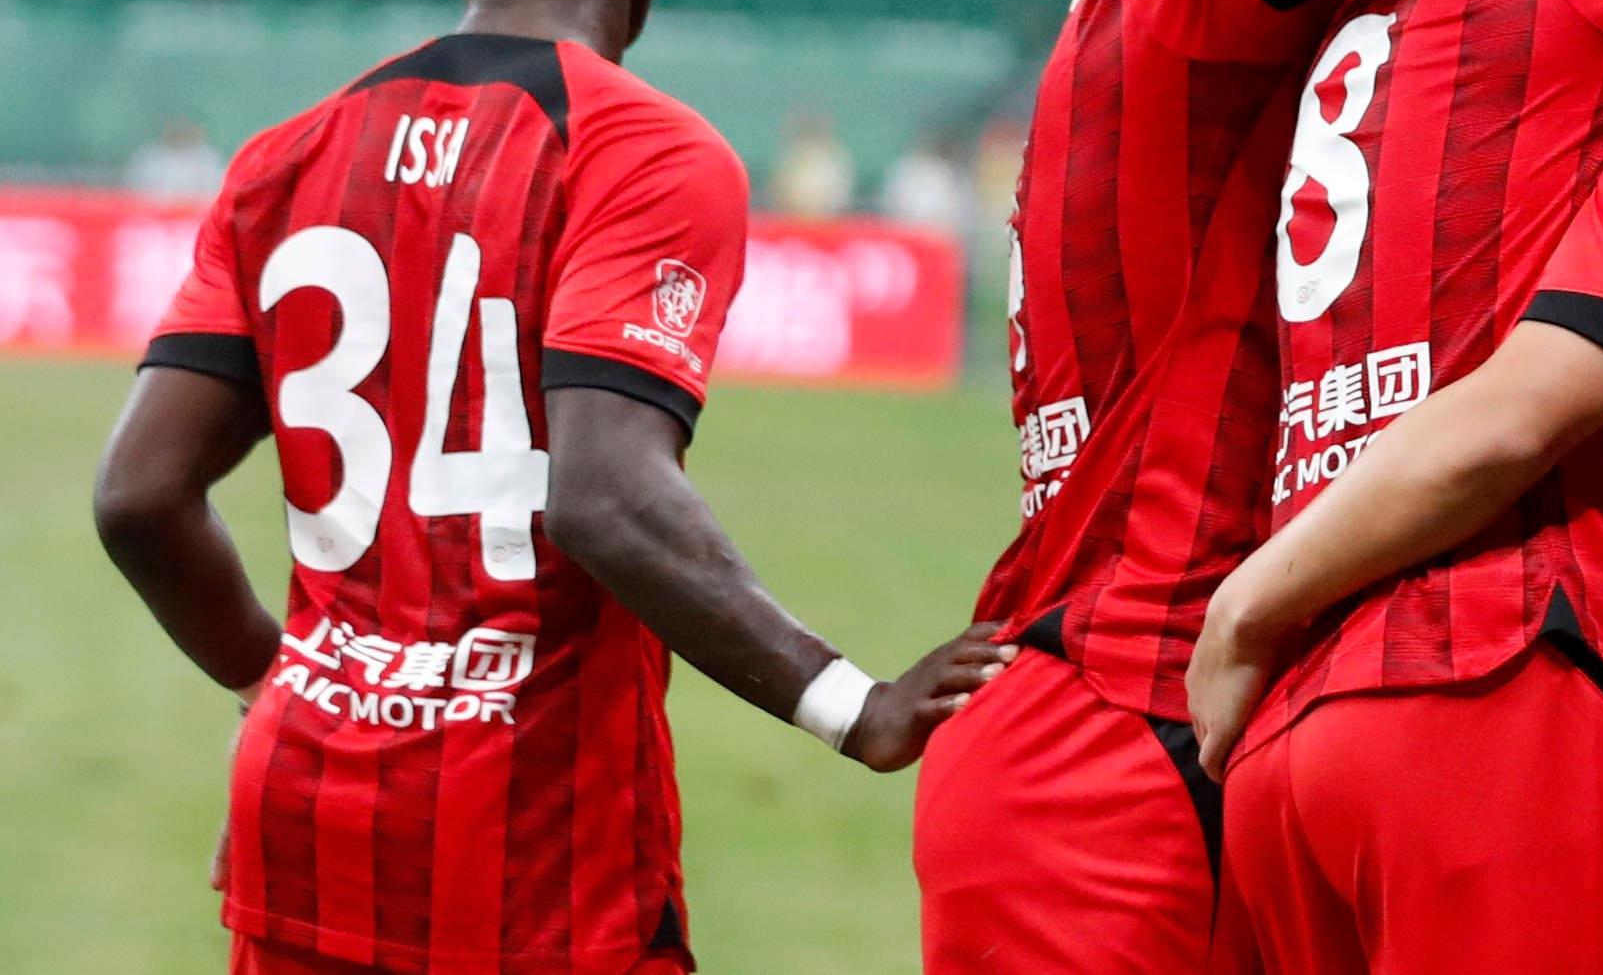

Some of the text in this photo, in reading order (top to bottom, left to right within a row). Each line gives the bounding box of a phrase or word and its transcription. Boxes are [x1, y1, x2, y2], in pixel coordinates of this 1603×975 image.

[385, 114, 470, 187] ISSA
[1276, 12, 1397, 323] 8
[258, 225, 551, 581] 34
[350, 691, 518, 731] MOTOR
